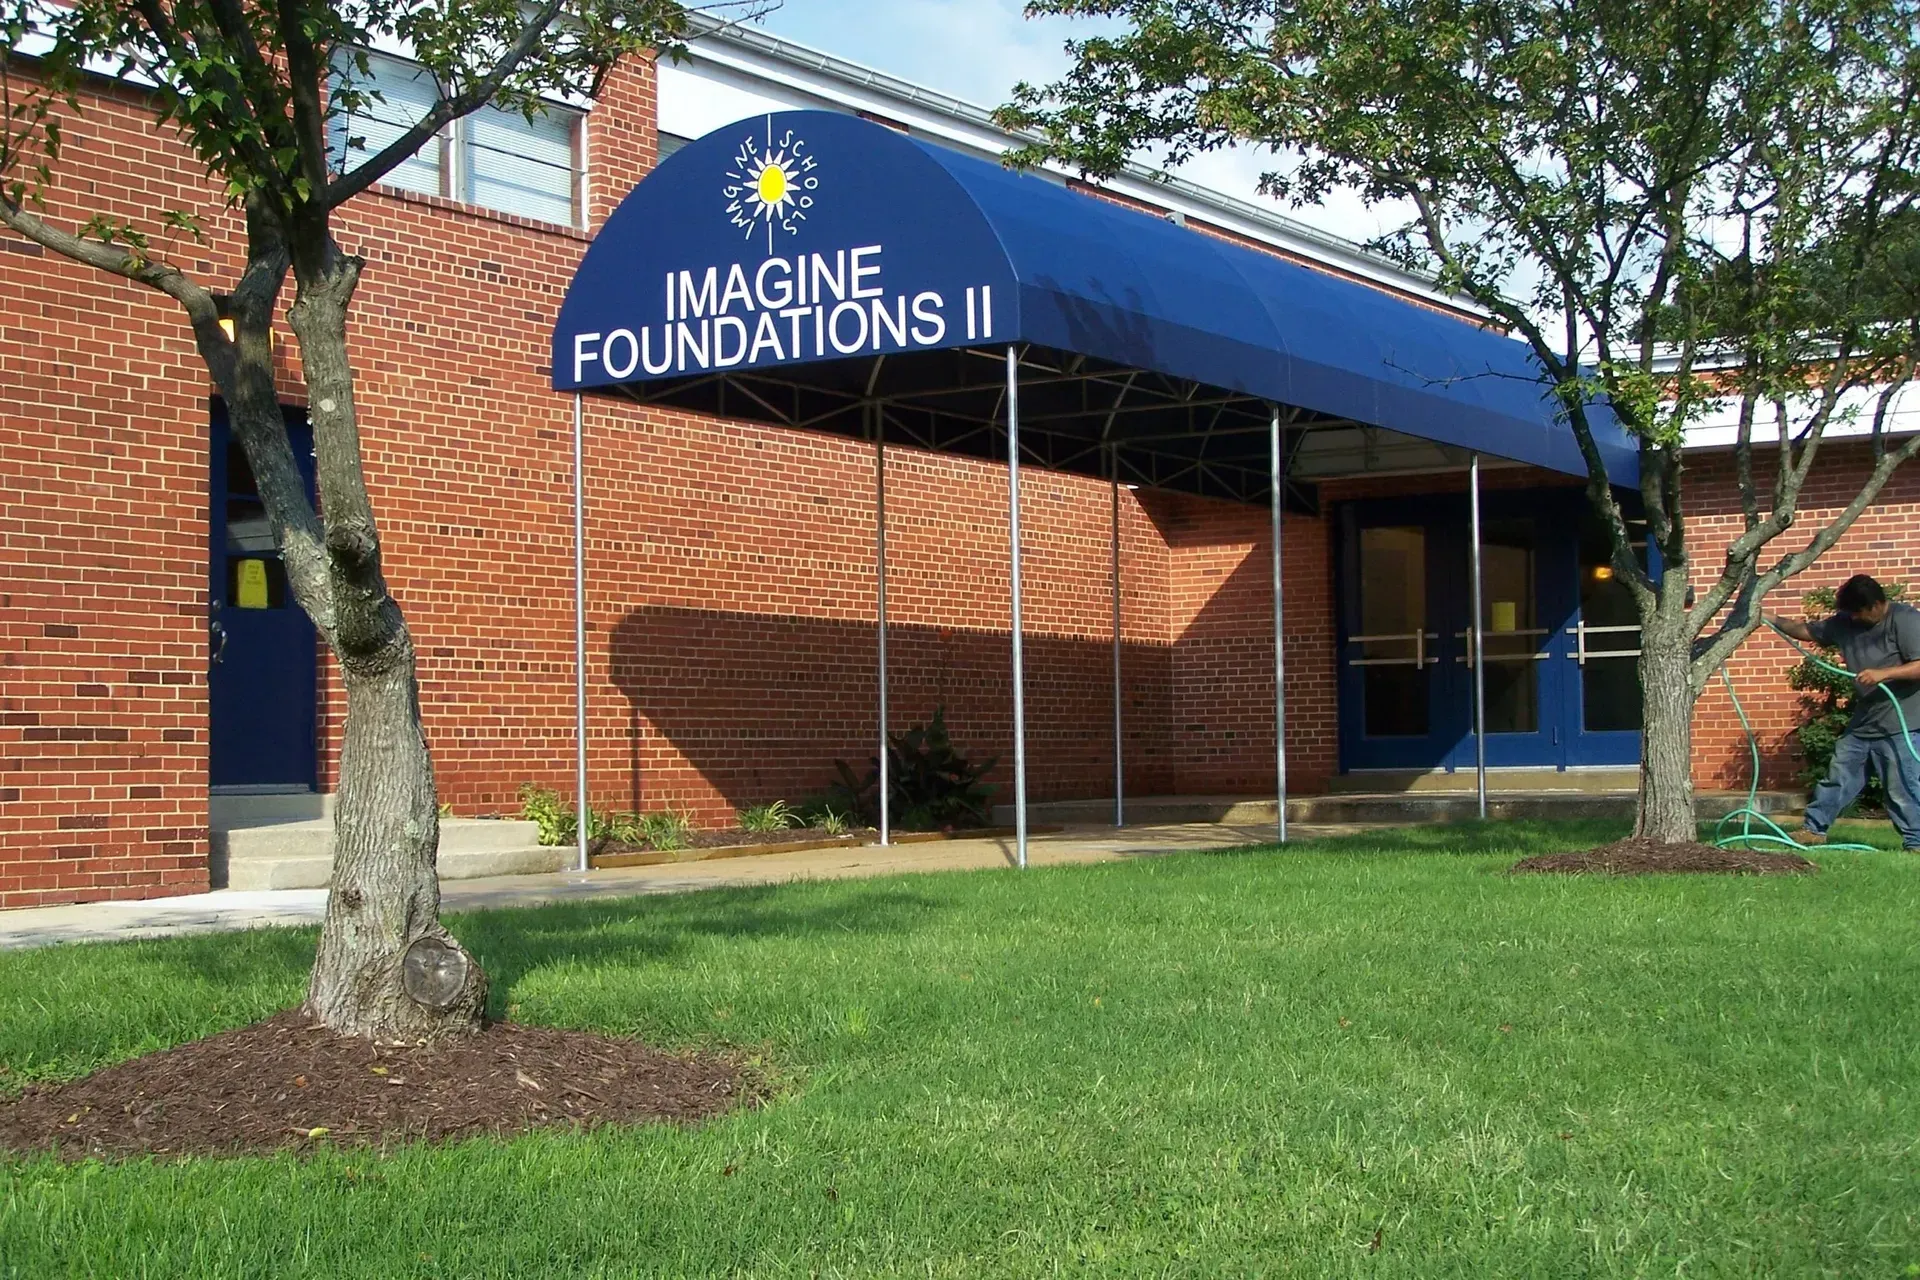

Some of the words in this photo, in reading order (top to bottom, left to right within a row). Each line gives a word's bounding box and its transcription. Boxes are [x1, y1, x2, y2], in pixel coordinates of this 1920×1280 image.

[722, 135, 758, 241] IMAGINE
[779, 129, 819, 236] SCHOOLS
[665, 244, 884, 322] IMAGINE
[573, 291, 946, 383] FOUNDATIONS
[965, 285, 992, 340] II
